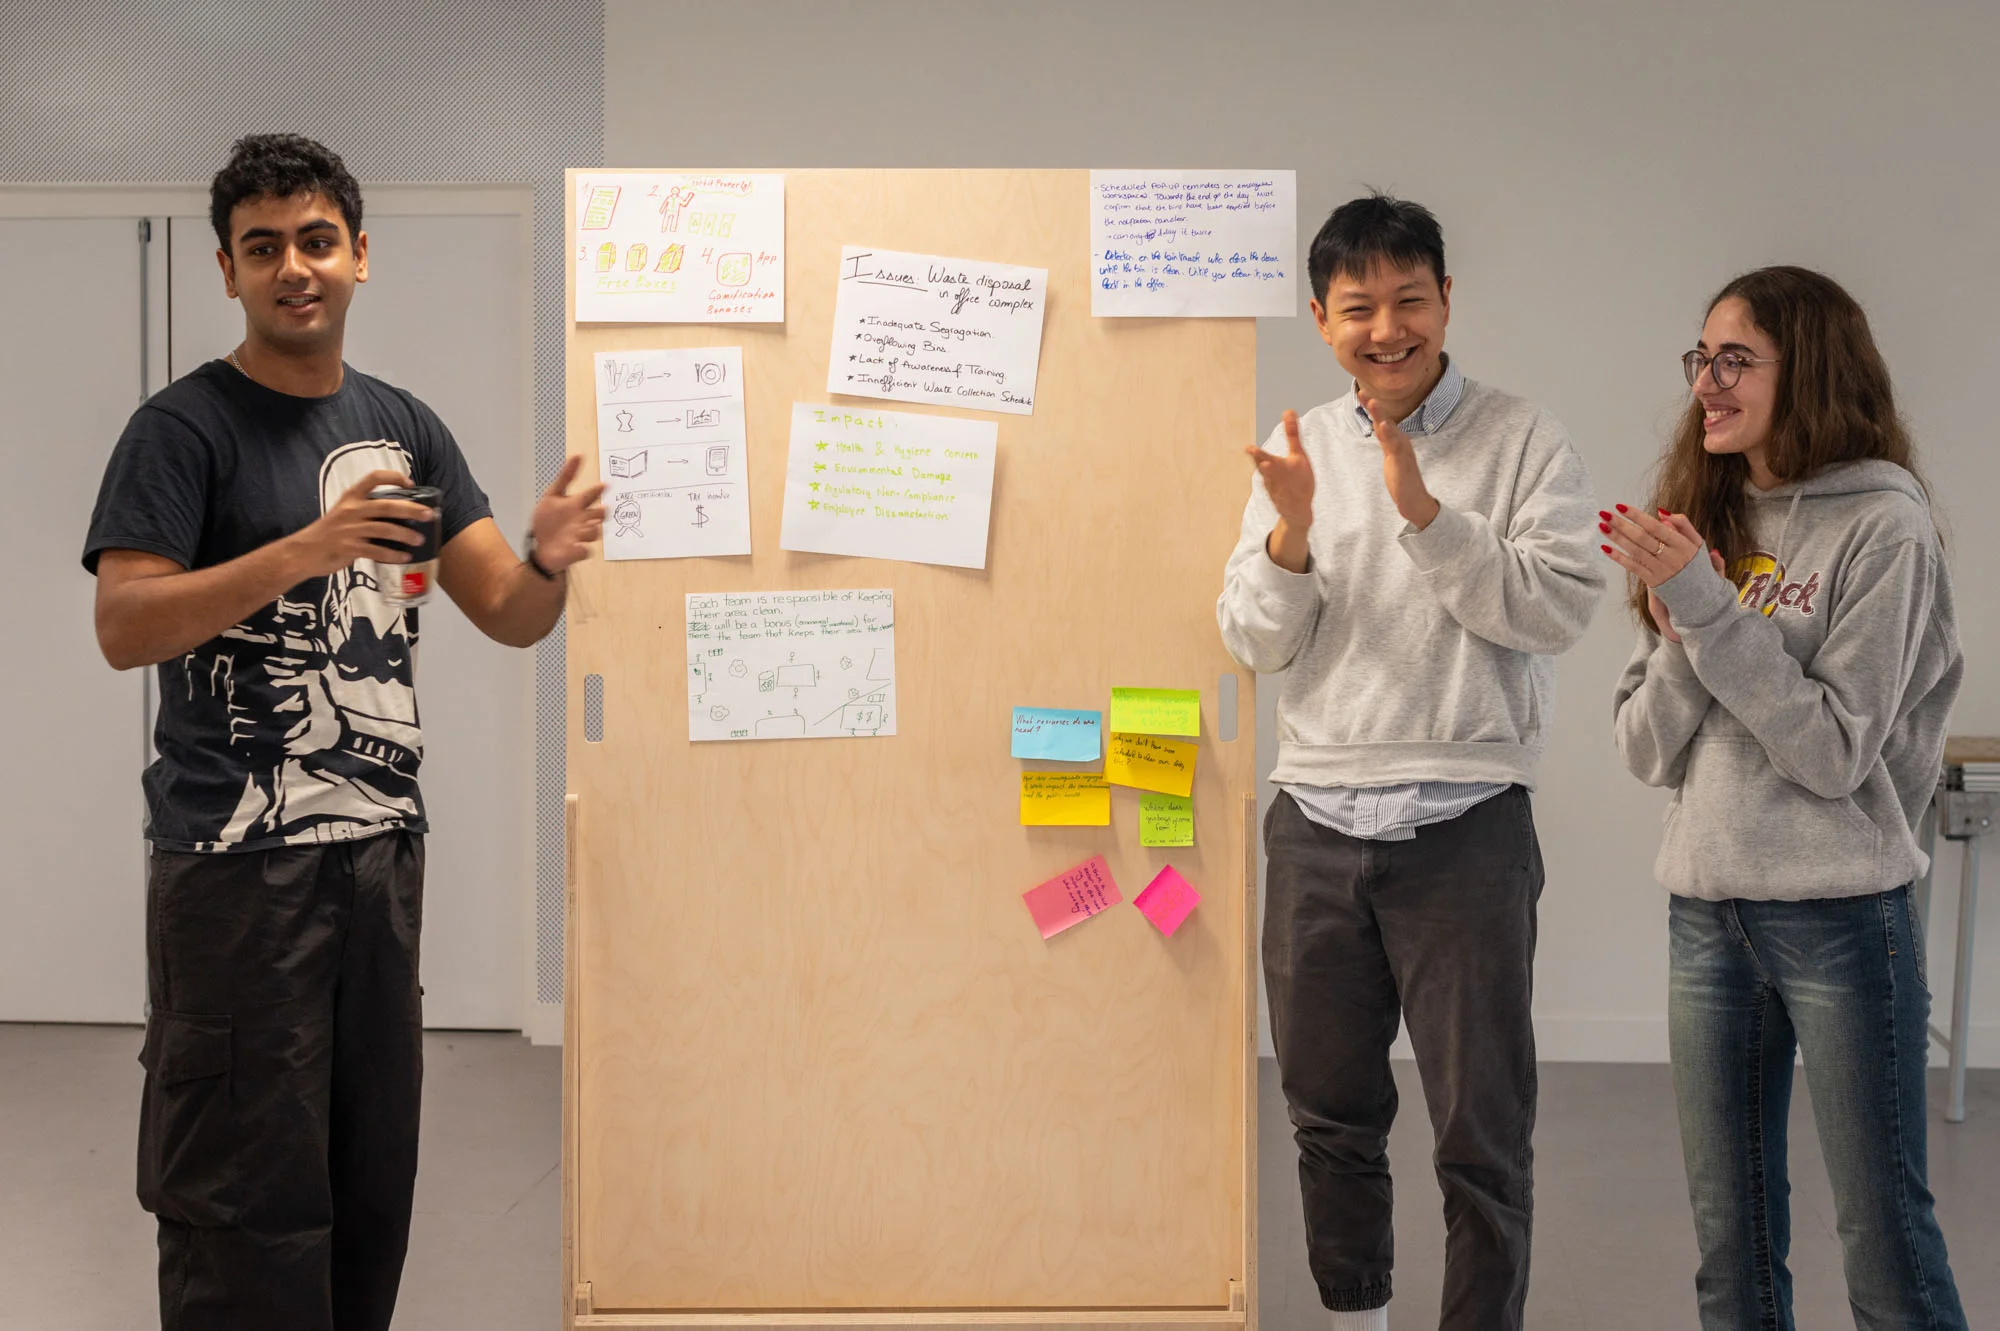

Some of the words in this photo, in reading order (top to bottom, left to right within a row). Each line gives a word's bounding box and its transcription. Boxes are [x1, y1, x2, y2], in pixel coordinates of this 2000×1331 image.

[1101, 181, 1147, 192] Scheduled
[1182, 183, 1220, 191] reminders
[1186, 191, 1197, 202] the
[1198, 192, 1212, 201] end
[1223, 191, 1235, 200] the
[1236, 191, 1250, 204] day
[1135, 203, 1153, 212] that
[1156, 203, 1169, 212] the
[1186, 202, 1203, 210] have
[1207, 202, 1223, 211] been
[1255, 201, 1277, 213] before
[1104, 217, 1115, 227] the
[1181, 227, 1189, 236] it
[1190, 228, 1213, 237] twice
[756, 250, 778, 265] App
[928, 264, 970, 285] Waste
[976, 274, 1033, 297] disposal
[1211, 270, 1228, 283] you
[938, 287, 950, 299] in
[951, 286, 981, 315] office
[988, 298, 1034, 315] complex
[867, 315, 926, 332] Inadequate
[863, 332, 916, 356] Overflowing
[858, 352, 885, 365] Lack
[887, 357, 900, 375] of
[900, 360, 952, 375] Awareness
[923, 380, 953, 395] Waste
[956, 385, 997, 399] Collection
[875, 440, 886, 457] &
[911, 466, 953, 486] Damage
[618, 509, 640, 521] GREEN
[689, 595, 720, 610] Each
[723, 592, 752, 608] team
[756, 595, 768, 605] is
[772, 591, 839, 610] responsible
[840, 591, 854, 602] of
[692, 608, 721, 621] their
[724, 609, 749, 619] area
[752, 605, 784, 617] clean.
[714, 617, 731, 631] will
[735, 618, 749, 631] be
[750, 620, 758, 630] a
[763, 616, 793, 630] bonus
[863, 612, 879, 626] for
[716, 630, 732, 642] the
[738, 628, 762, 641] team
[765, 627, 783, 639] that
[1015, 713, 1034, 726] What
[1072, 715, 1081, 726] do
